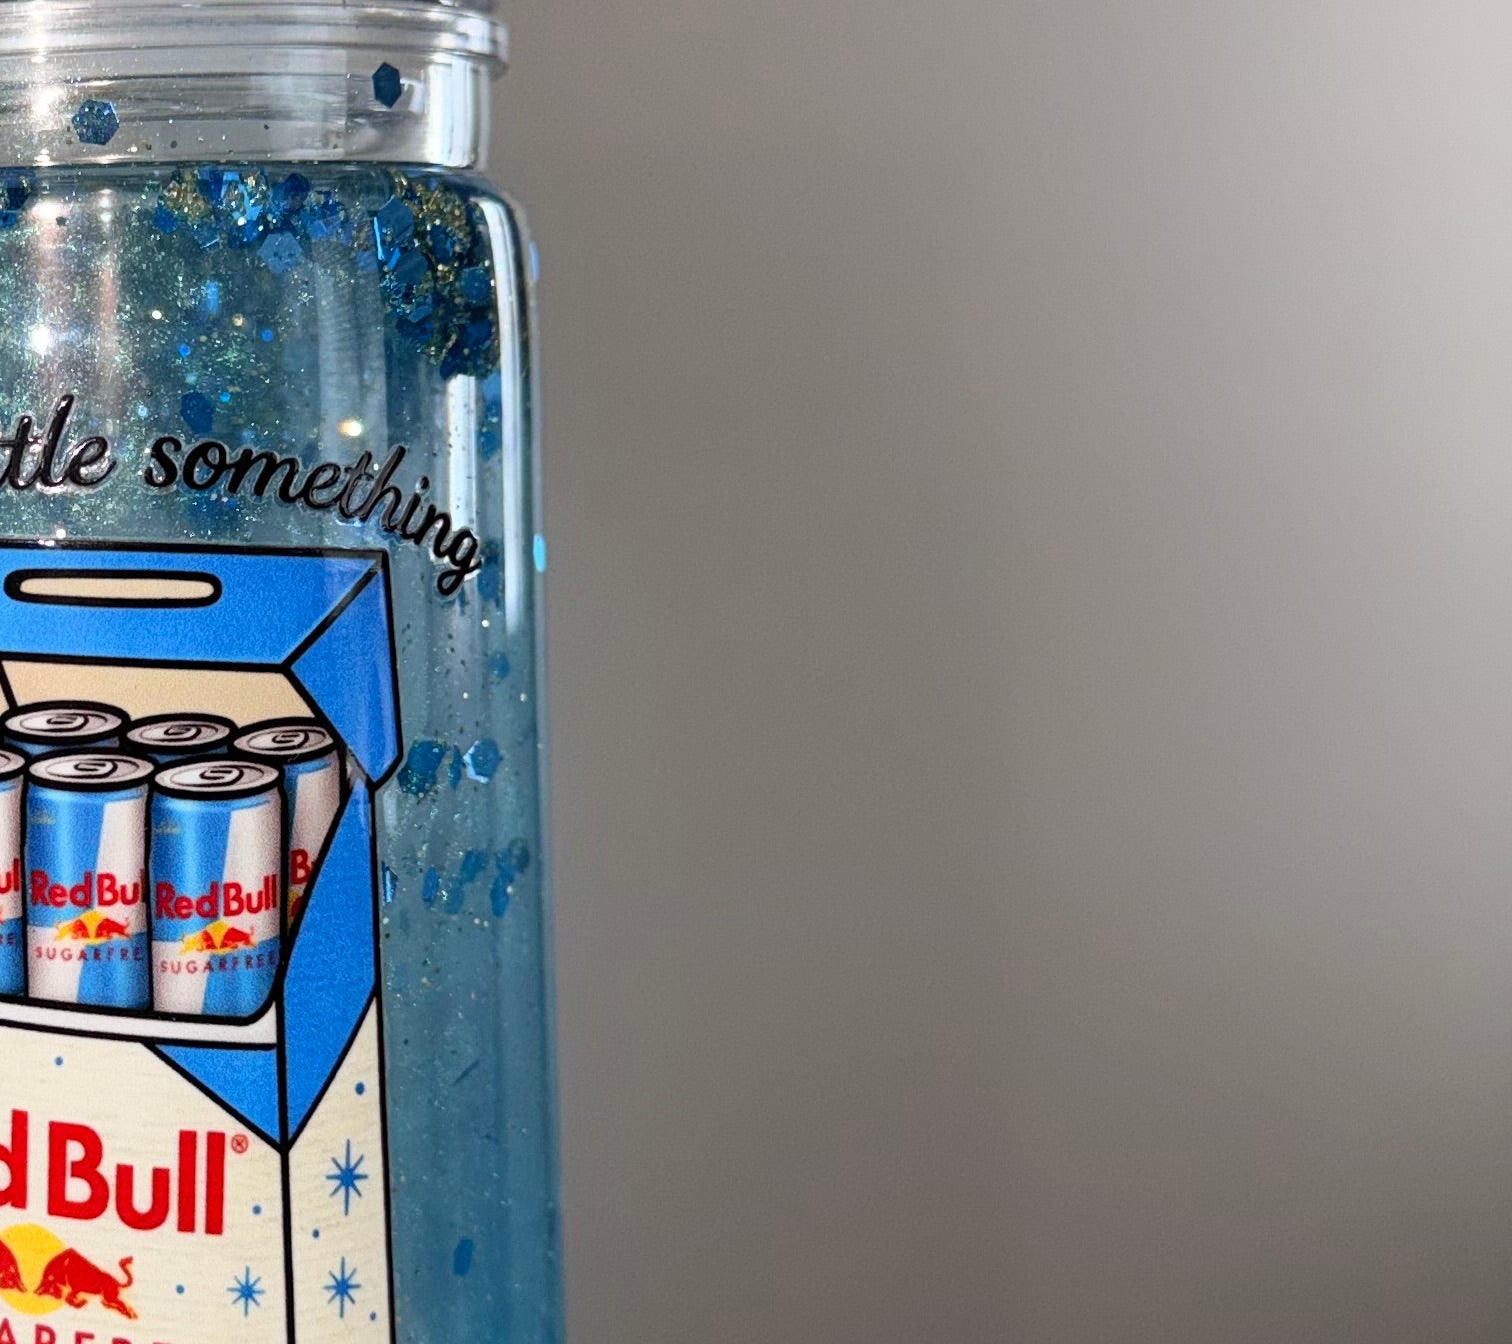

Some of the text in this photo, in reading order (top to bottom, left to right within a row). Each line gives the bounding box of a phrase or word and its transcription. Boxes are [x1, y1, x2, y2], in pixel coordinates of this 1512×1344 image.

[143, 433, 483, 596] something
[30, 870, 92, 908] Red
[155, 874, 277, 920] Red Bull
